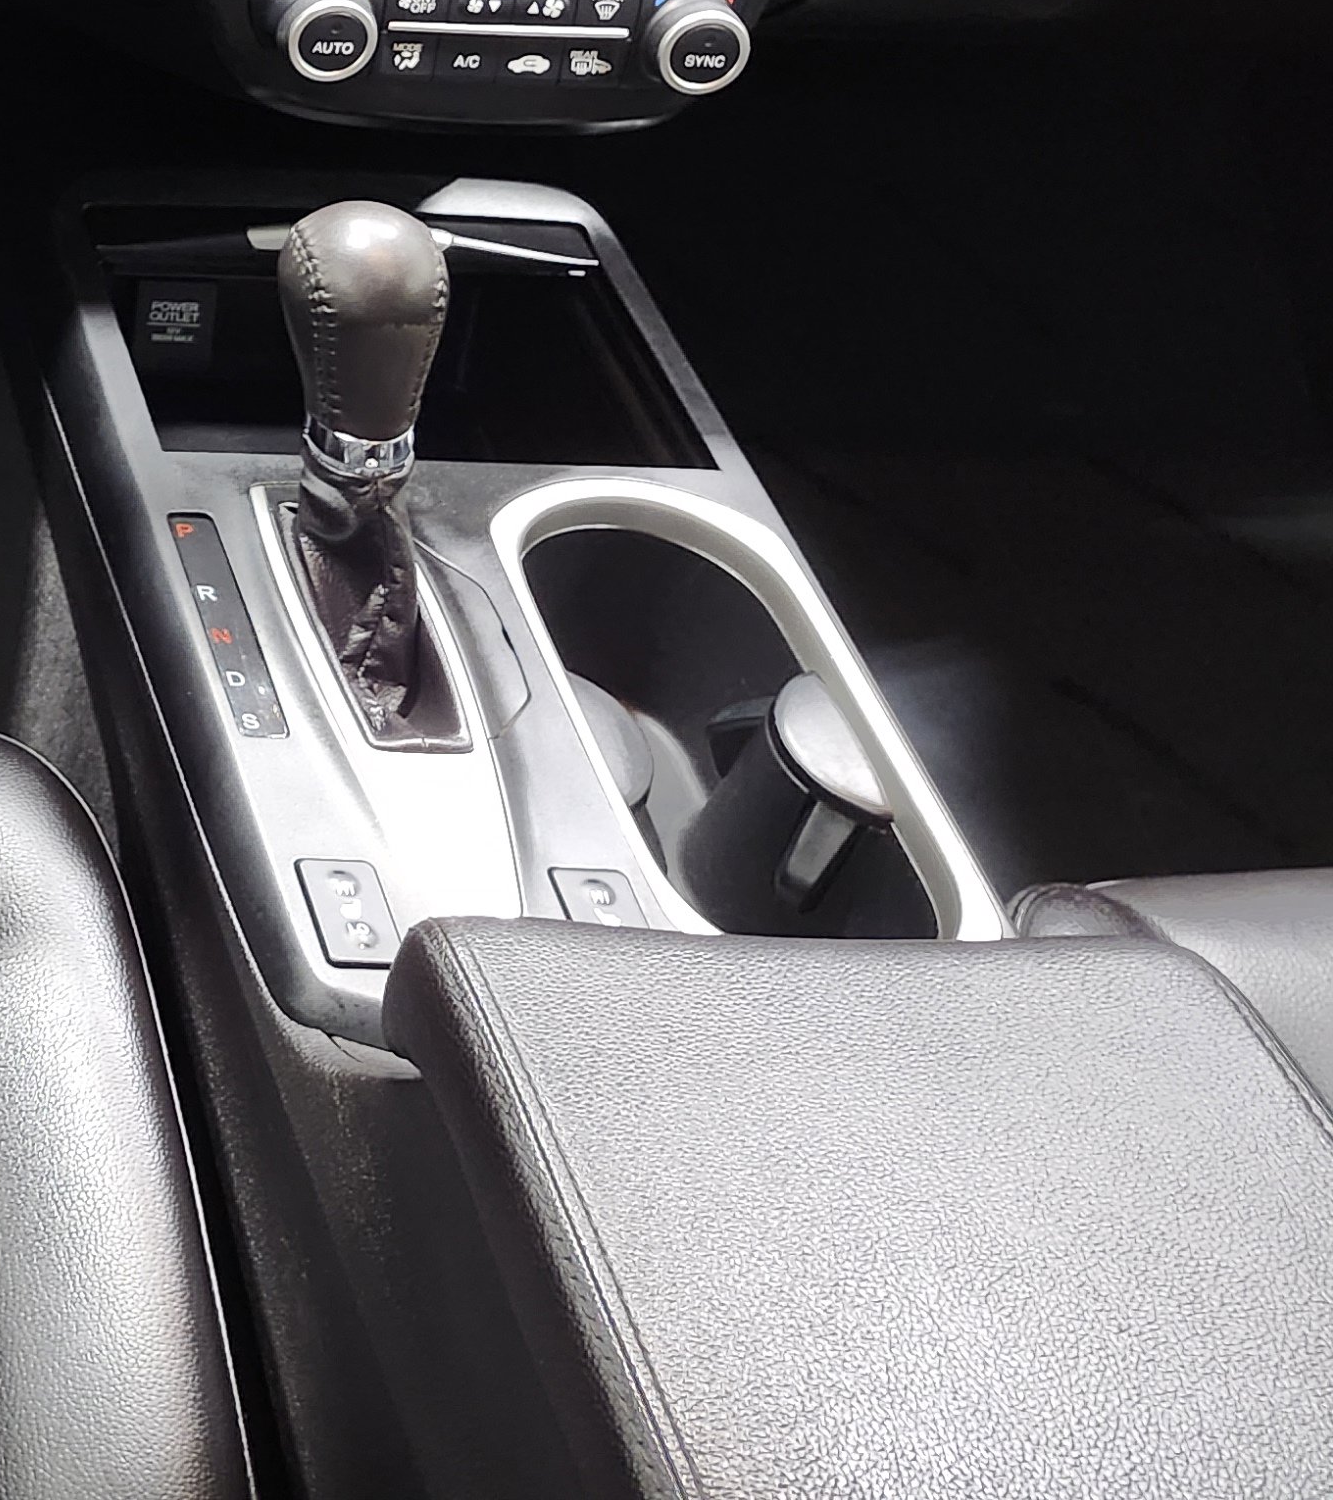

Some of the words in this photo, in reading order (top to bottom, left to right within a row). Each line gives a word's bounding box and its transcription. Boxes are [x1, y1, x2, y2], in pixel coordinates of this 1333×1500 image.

[410, 1, 437, 14] OFF
[312, 41, 355, 55] AUTO
[393, 43, 423, 52] MODE
[453, 54, 481, 69] A/C
[569, 50, 598, 61] REAR
[684, 53, 726, 68] SYNC
[151, 301, 199, 311] POWER
[149, 311, 200, 322] OUTLET
[175, 523, 194, 538] P
[196, 584, 218, 602] R
[209, 627, 233, 645] N
[225, 671, 246, 687] D
[241, 713, 261, 730] S
